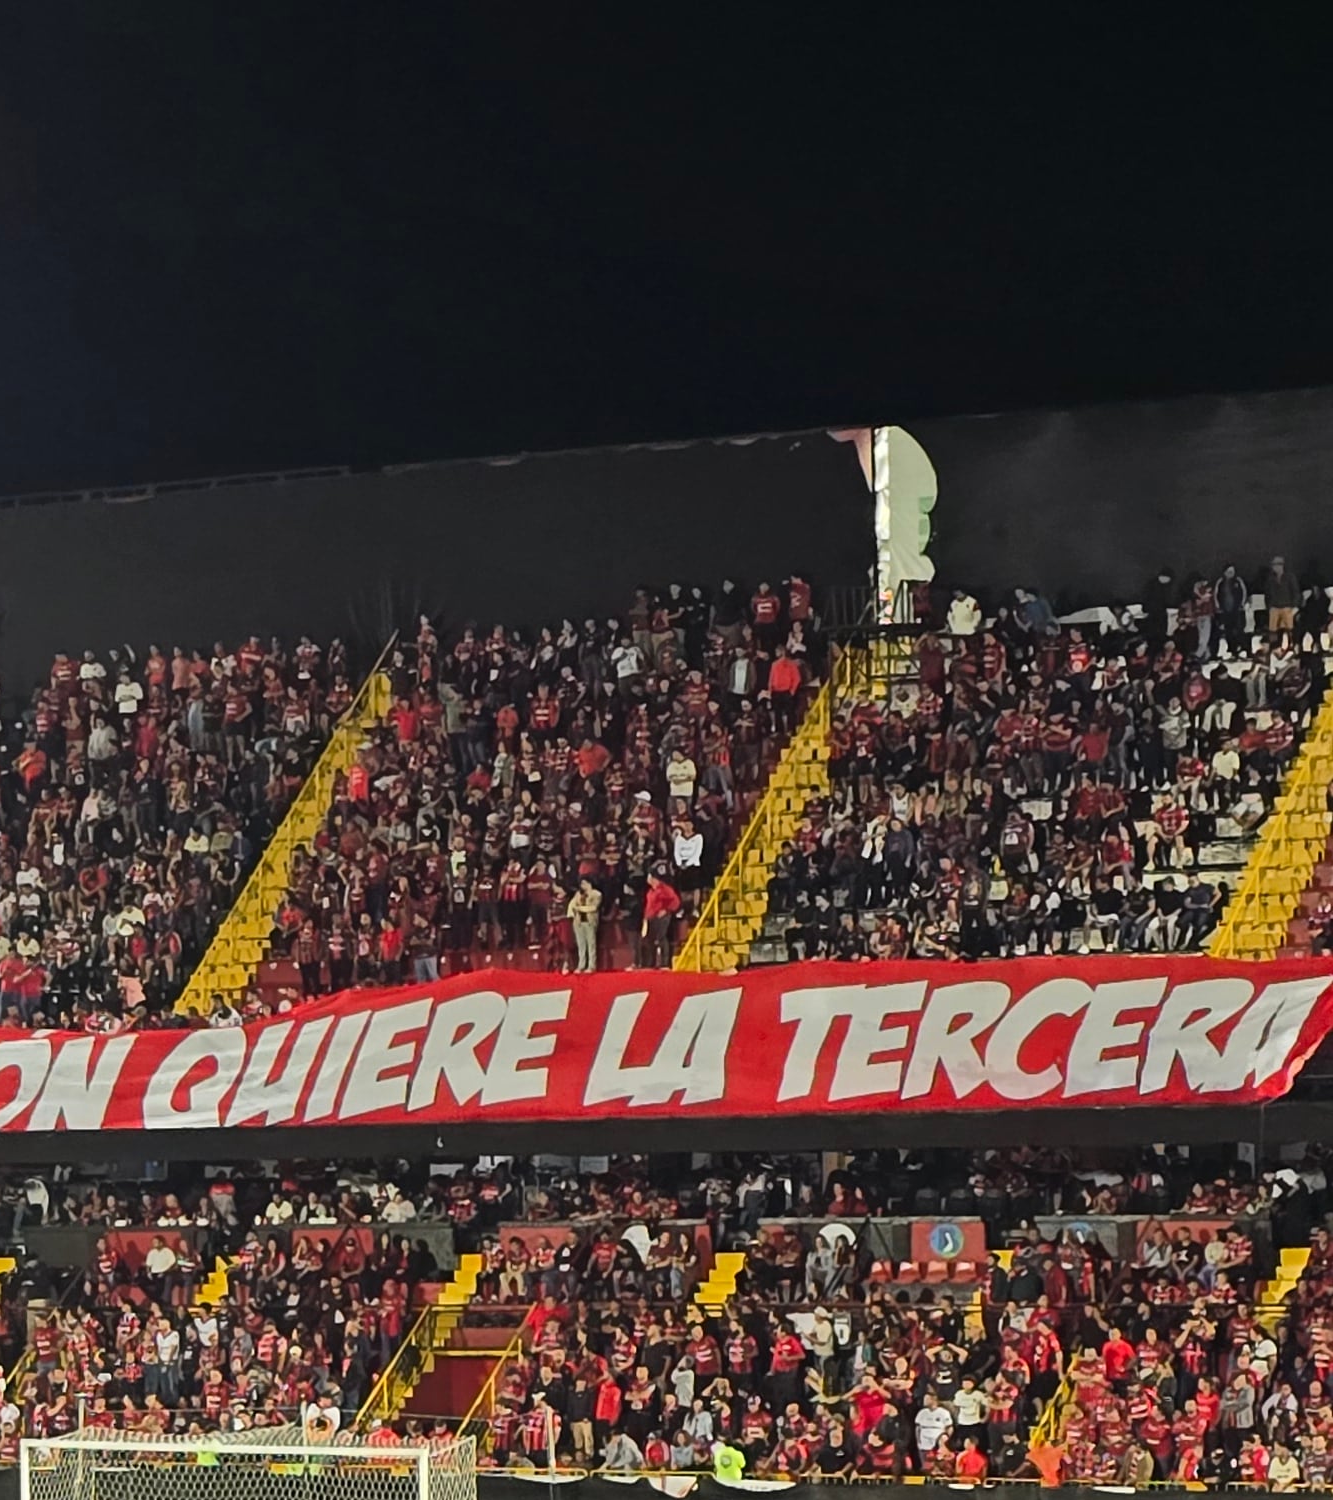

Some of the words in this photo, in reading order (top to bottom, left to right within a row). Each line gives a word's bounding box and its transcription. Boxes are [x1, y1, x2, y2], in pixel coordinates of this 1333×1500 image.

[144, 989, 572, 1128] QUIERE
[583, 986, 741, 1107] LA
[777, 975, 1332, 1104] TERCERA
